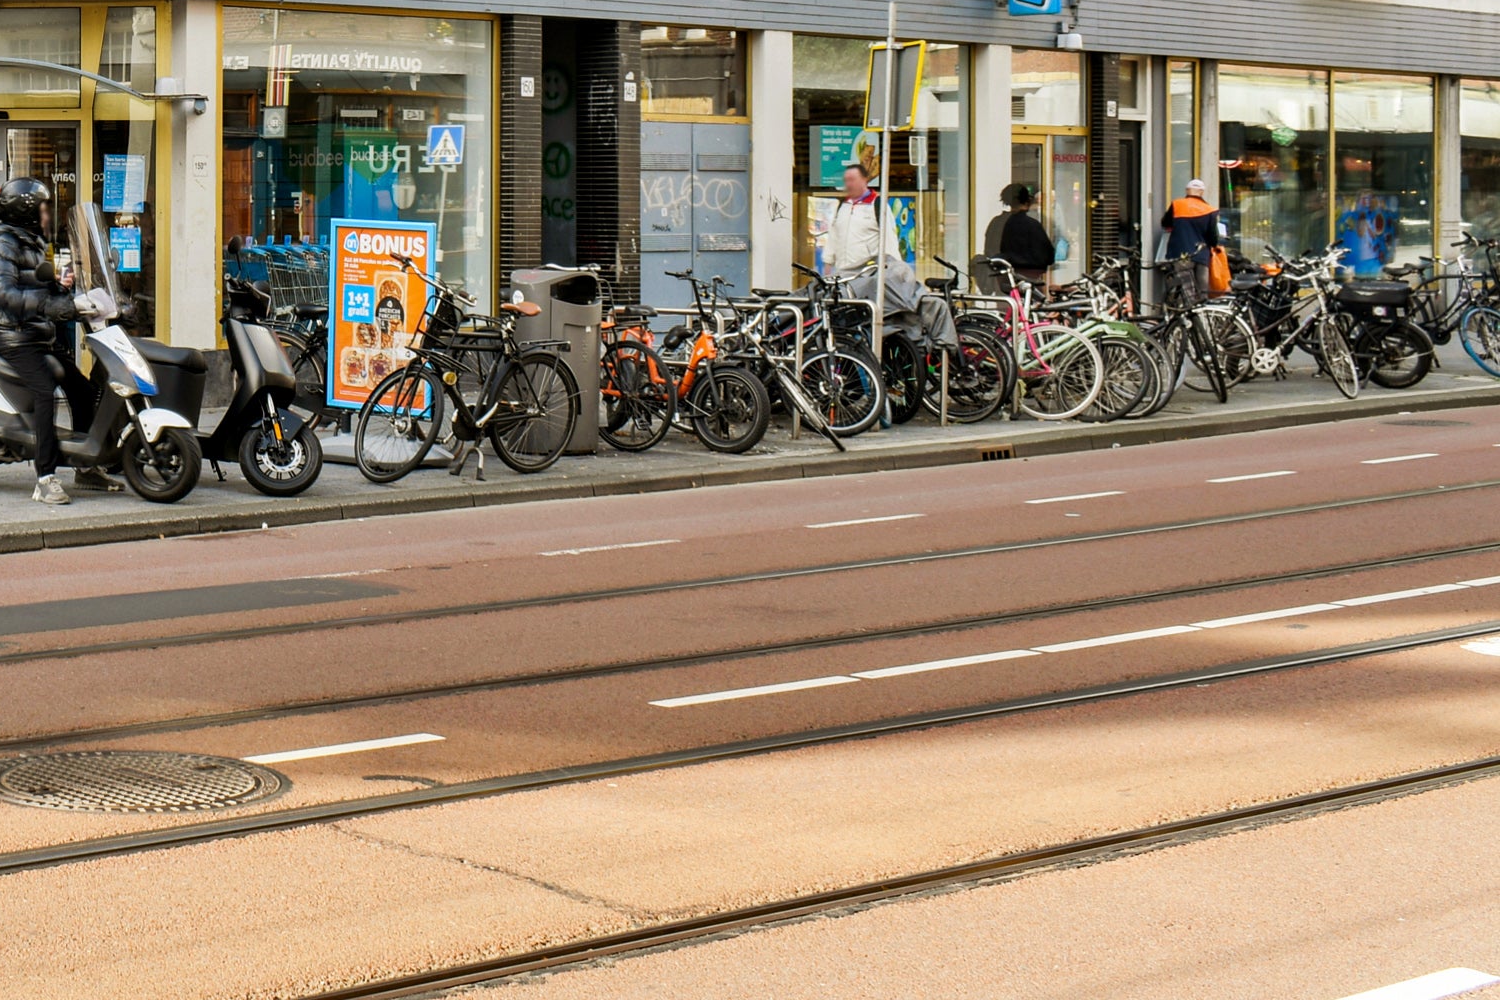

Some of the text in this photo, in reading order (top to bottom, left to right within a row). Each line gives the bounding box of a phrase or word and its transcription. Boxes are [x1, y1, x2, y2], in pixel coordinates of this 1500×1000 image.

[289, 146, 343, 167] budbee
[359, 233, 426, 258] BONUS
[348, 291, 370, 308] 1+1
[347, 306, 370, 317] gratis
